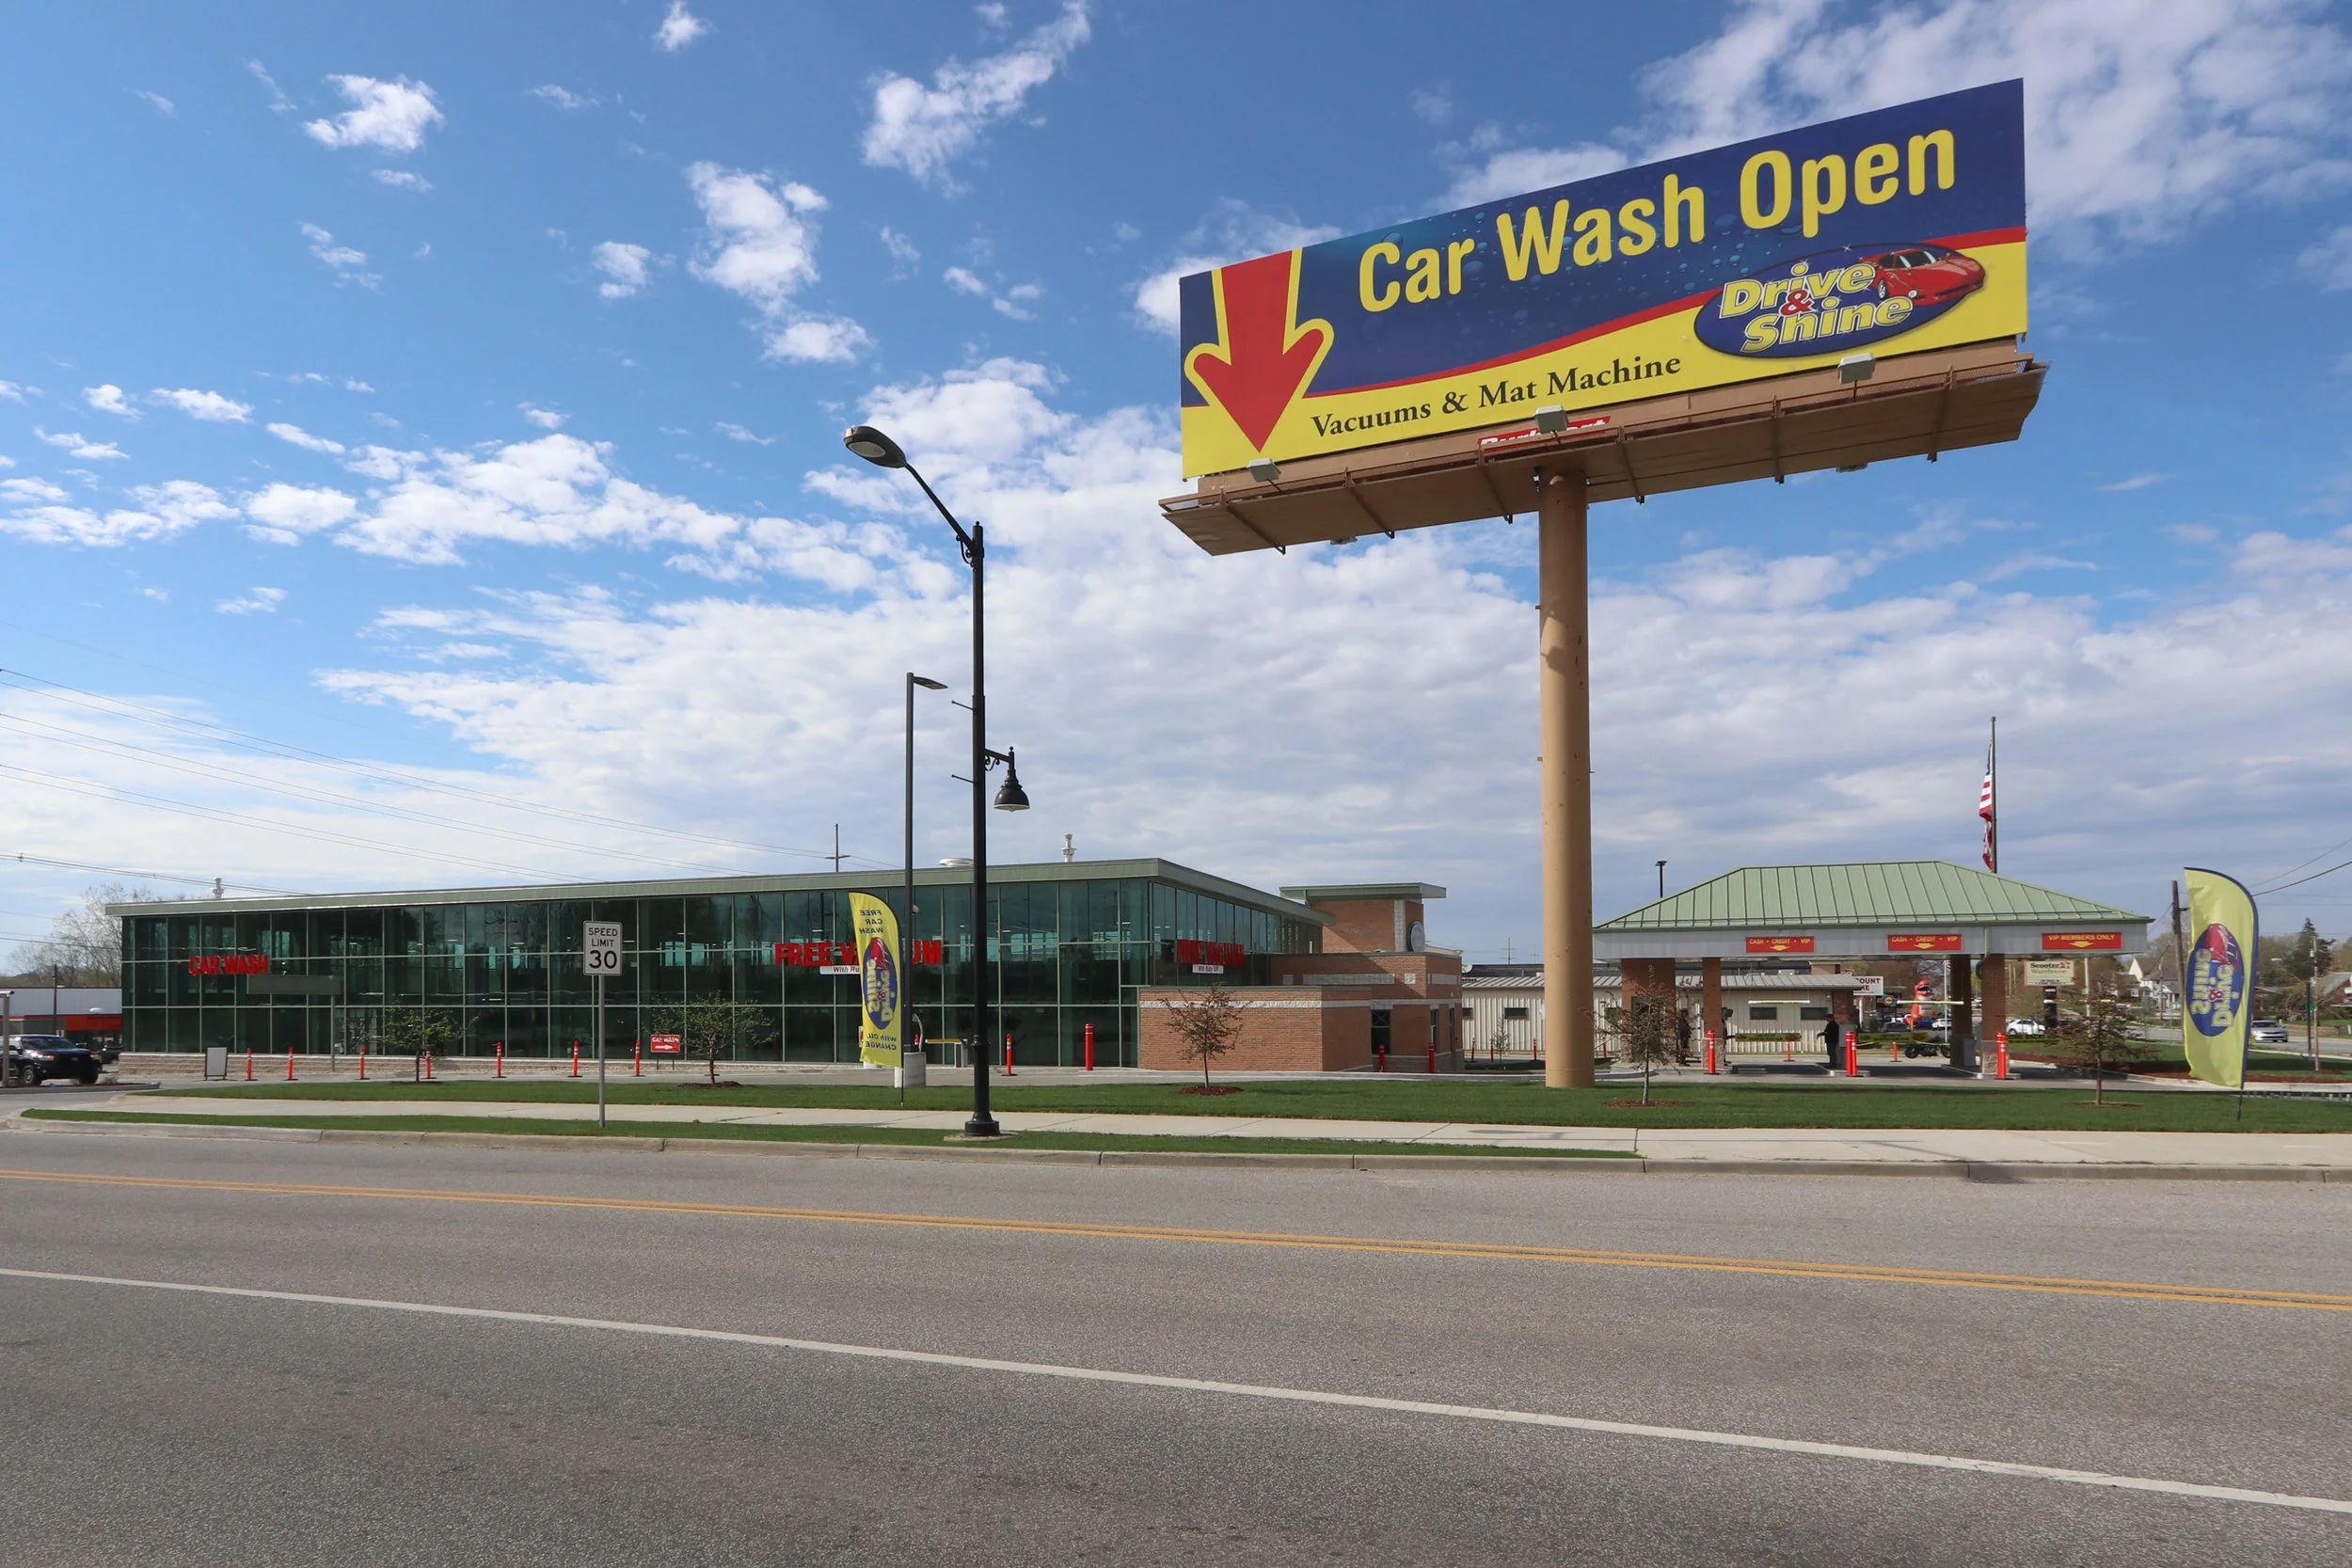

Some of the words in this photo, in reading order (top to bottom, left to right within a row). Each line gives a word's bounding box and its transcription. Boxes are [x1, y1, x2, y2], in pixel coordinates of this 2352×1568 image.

[1359, 237, 1475, 312] Car
[1496, 173, 1706, 282] Wash
[1740, 129, 1955, 239] Open
[1719, 262, 1876, 319] Drive
[1780, 289, 1812, 316] &
[1740, 295, 1914, 354] Shine
[1311, 404, 1432, 437] Vacuums
[1441, 391, 1470, 415] &
[1478, 380, 1537, 408] Mat
[1547, 356, 1682, 396] Machine
[588, 927, 618, 937] SPEED
[591, 939, 614, 947] LIMIT
[589, 950, 617, 969] 30
[774, 942, 833, 967] FREE
[1176, 939, 1204, 964] FREE
[188, 955, 222, 975] CAR
[224, 954, 269, 974] WASH
